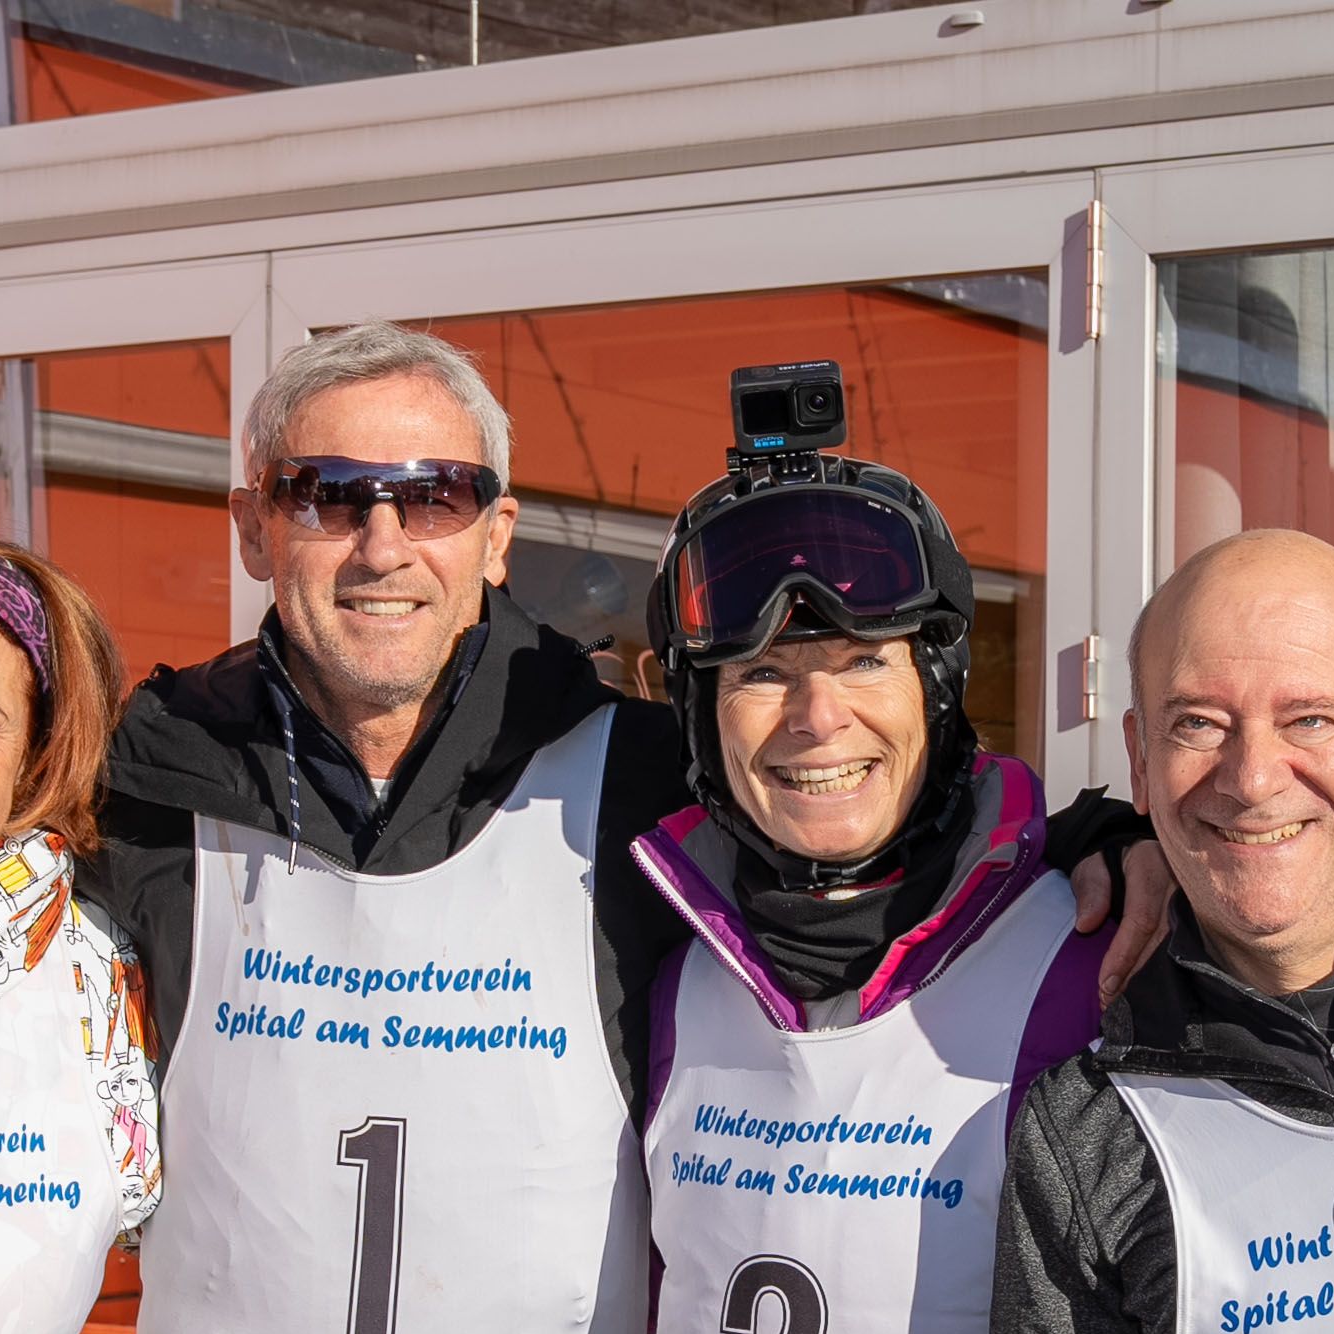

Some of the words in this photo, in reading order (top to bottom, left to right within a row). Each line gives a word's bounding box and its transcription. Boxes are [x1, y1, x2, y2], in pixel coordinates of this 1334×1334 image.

[244, 946, 532, 998] Wintersportverein
[214, 1002, 306, 1040] Spital
[315, 1019, 370, 1049] am
[381, 1015, 567, 1059] Semmering
[695, 1104, 932, 1149] Wintersportverein
[672, 1152, 729, 1188] Spital
[735, 1168, 775, 1195] am
[783, 1164, 964, 1210] Semmering
